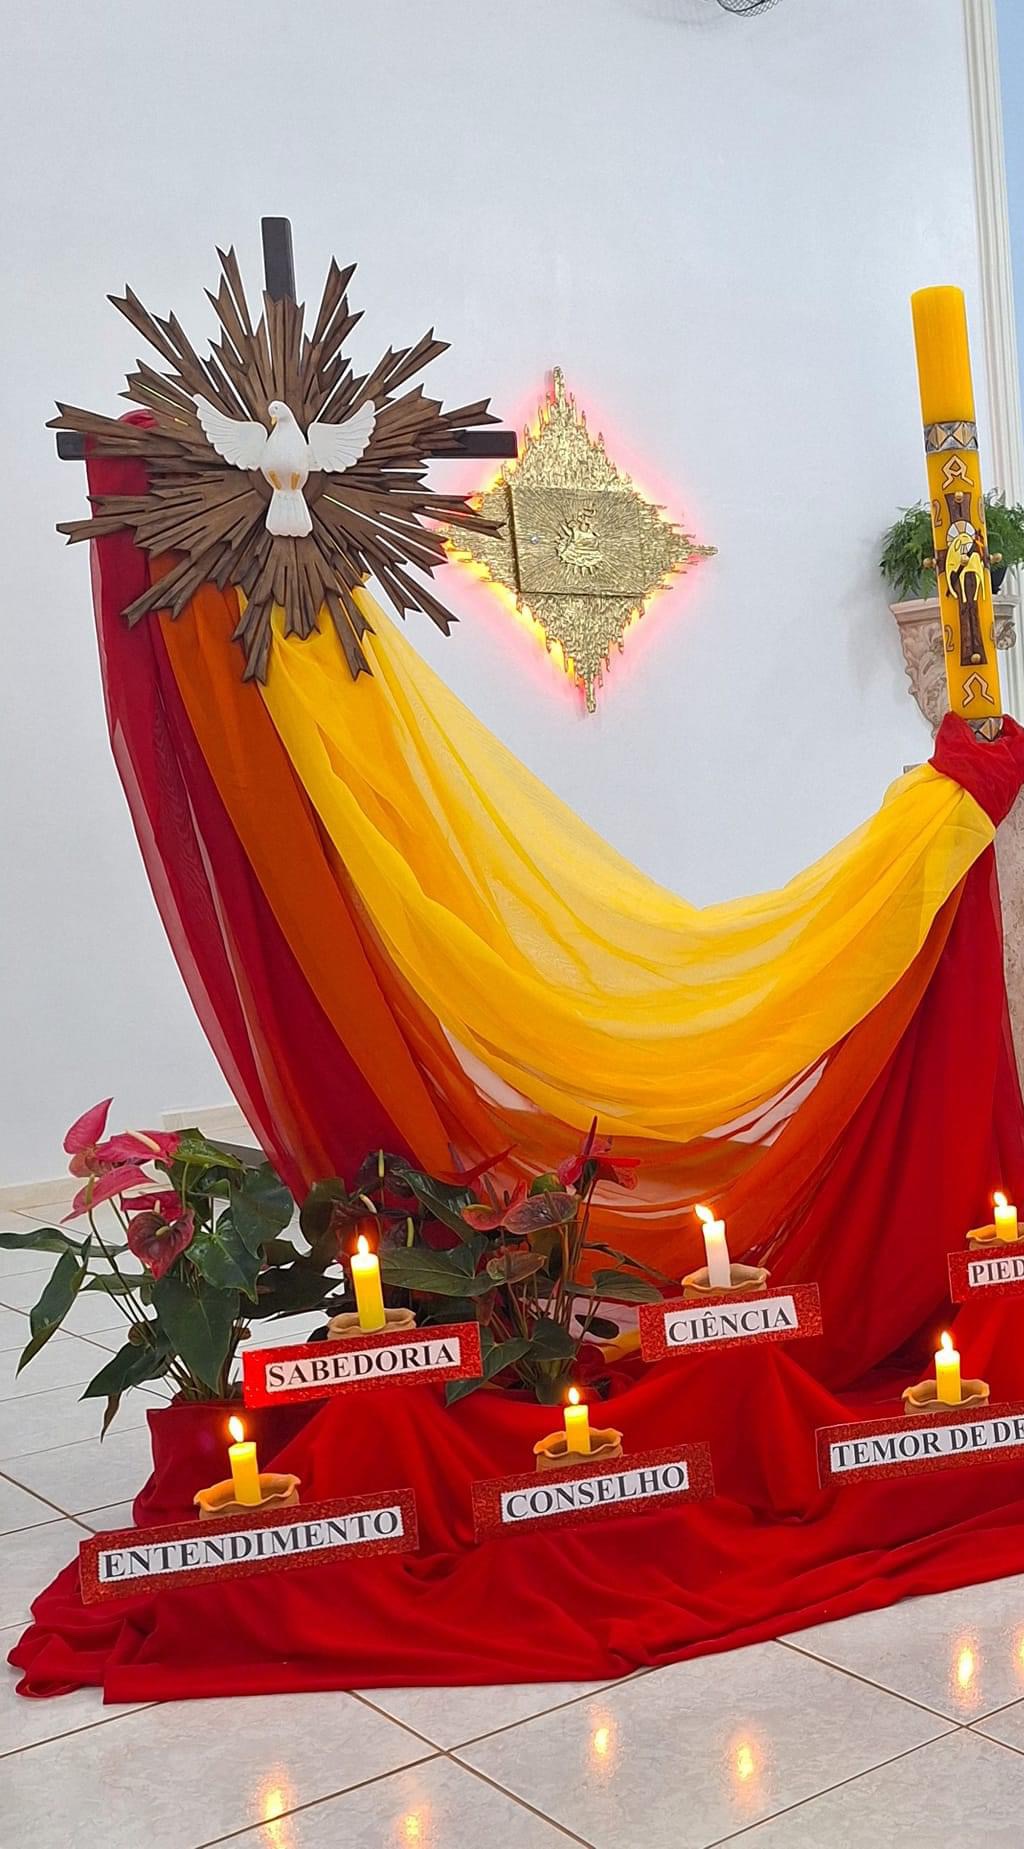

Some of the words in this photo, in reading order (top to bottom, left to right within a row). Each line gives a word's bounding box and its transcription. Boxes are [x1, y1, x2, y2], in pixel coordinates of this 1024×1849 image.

[667, 1307, 793, 1344] CIÊNCIA
[268, 1343, 457, 1388] SABEDORIA
[832, 1432, 942, 1468] TEMOR
[949, 1424, 988, 1451] DE
[505, 1465, 685, 1520] CONSELHO
[102, 1510, 399, 1580] ENTENDIMENTO
